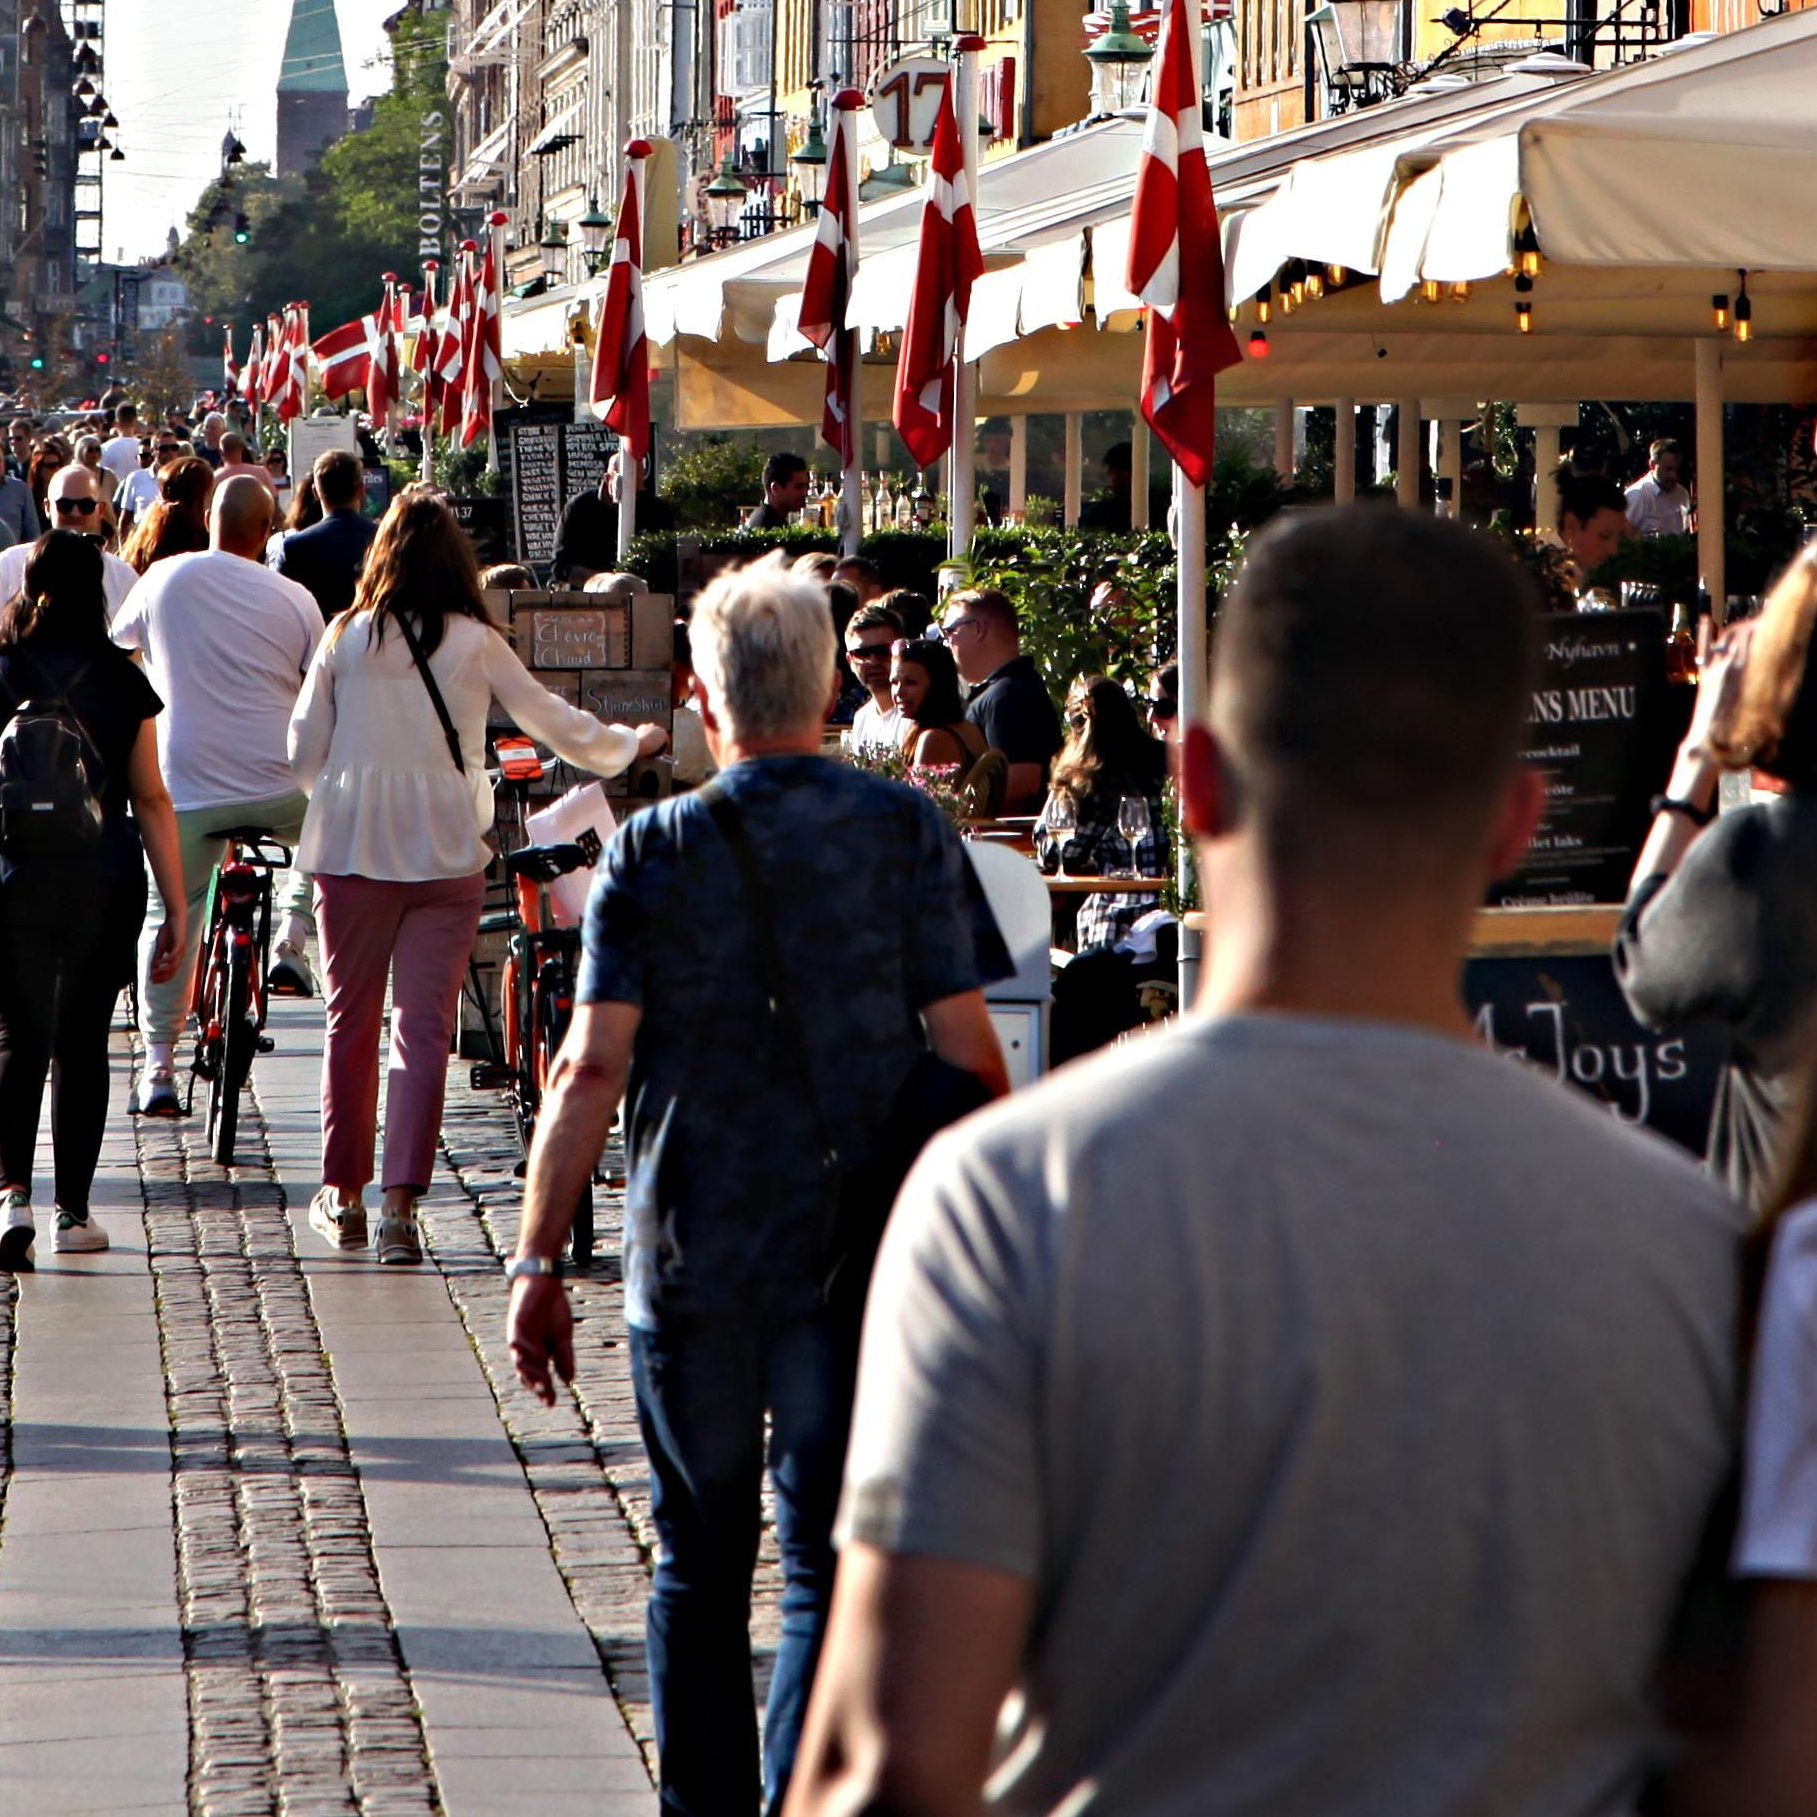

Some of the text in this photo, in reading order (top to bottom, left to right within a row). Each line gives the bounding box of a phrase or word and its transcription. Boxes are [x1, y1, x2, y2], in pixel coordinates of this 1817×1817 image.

[880, 71, 950, 146] 17
[419, 110, 443, 255] BOLTENS
[1546, 634, 1620, 669] Nyhavn
[1528, 686, 1635, 722] NS MENU
[1519, 744, 1581, 759] cocktail
